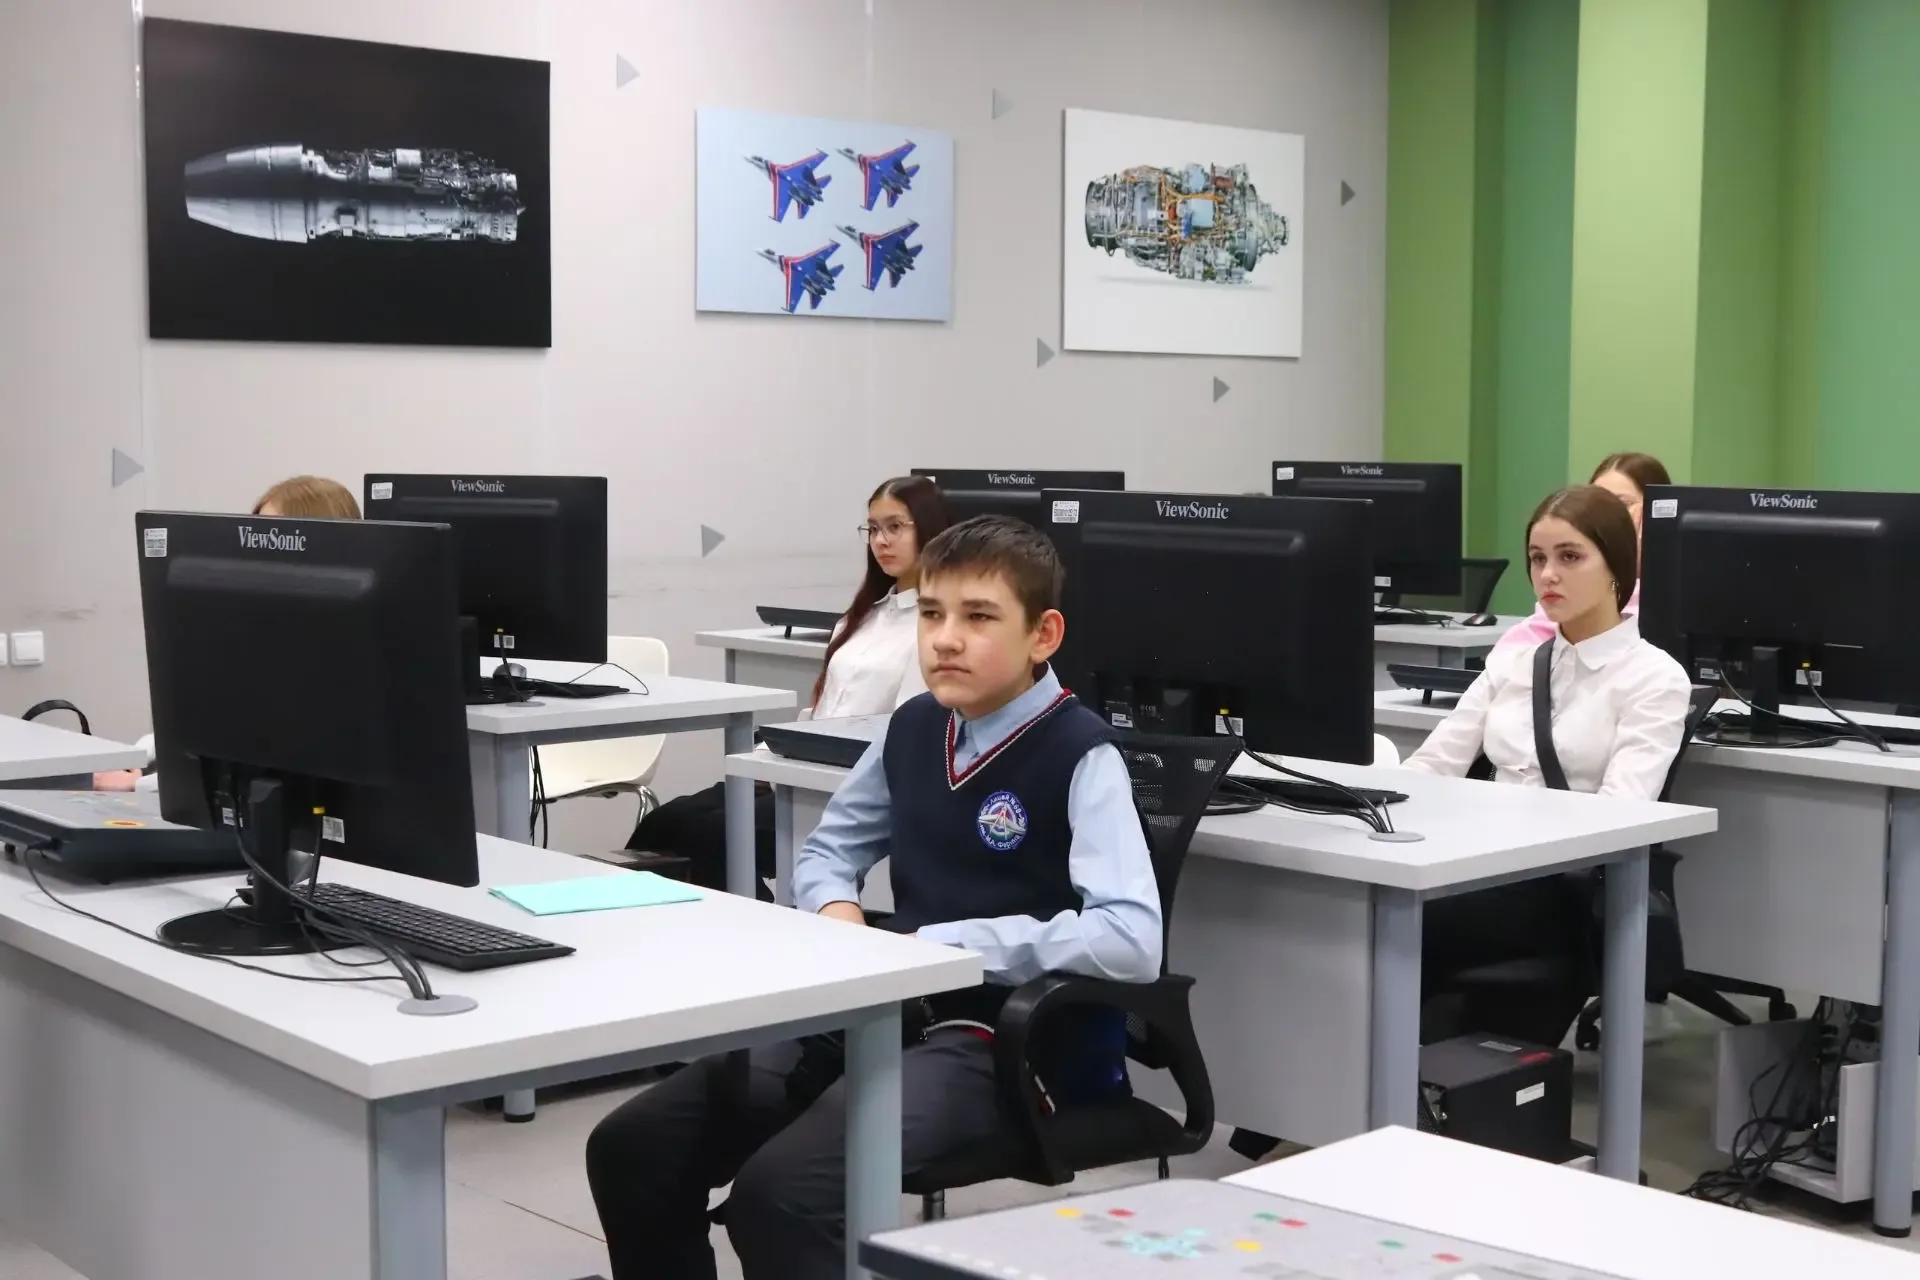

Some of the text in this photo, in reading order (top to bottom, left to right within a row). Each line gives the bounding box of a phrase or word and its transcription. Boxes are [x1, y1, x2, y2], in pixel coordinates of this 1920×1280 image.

[1340, 465, 1384, 476] ViewSonic
[451, 479, 506, 493] ViewSonic
[987, 473, 1036, 485] ViewSonic
[1750, 493, 1818, 509] ViewSonic
[1155, 500, 1229, 520] ViewSonic
[237, 525, 306, 552] ViewSonic
